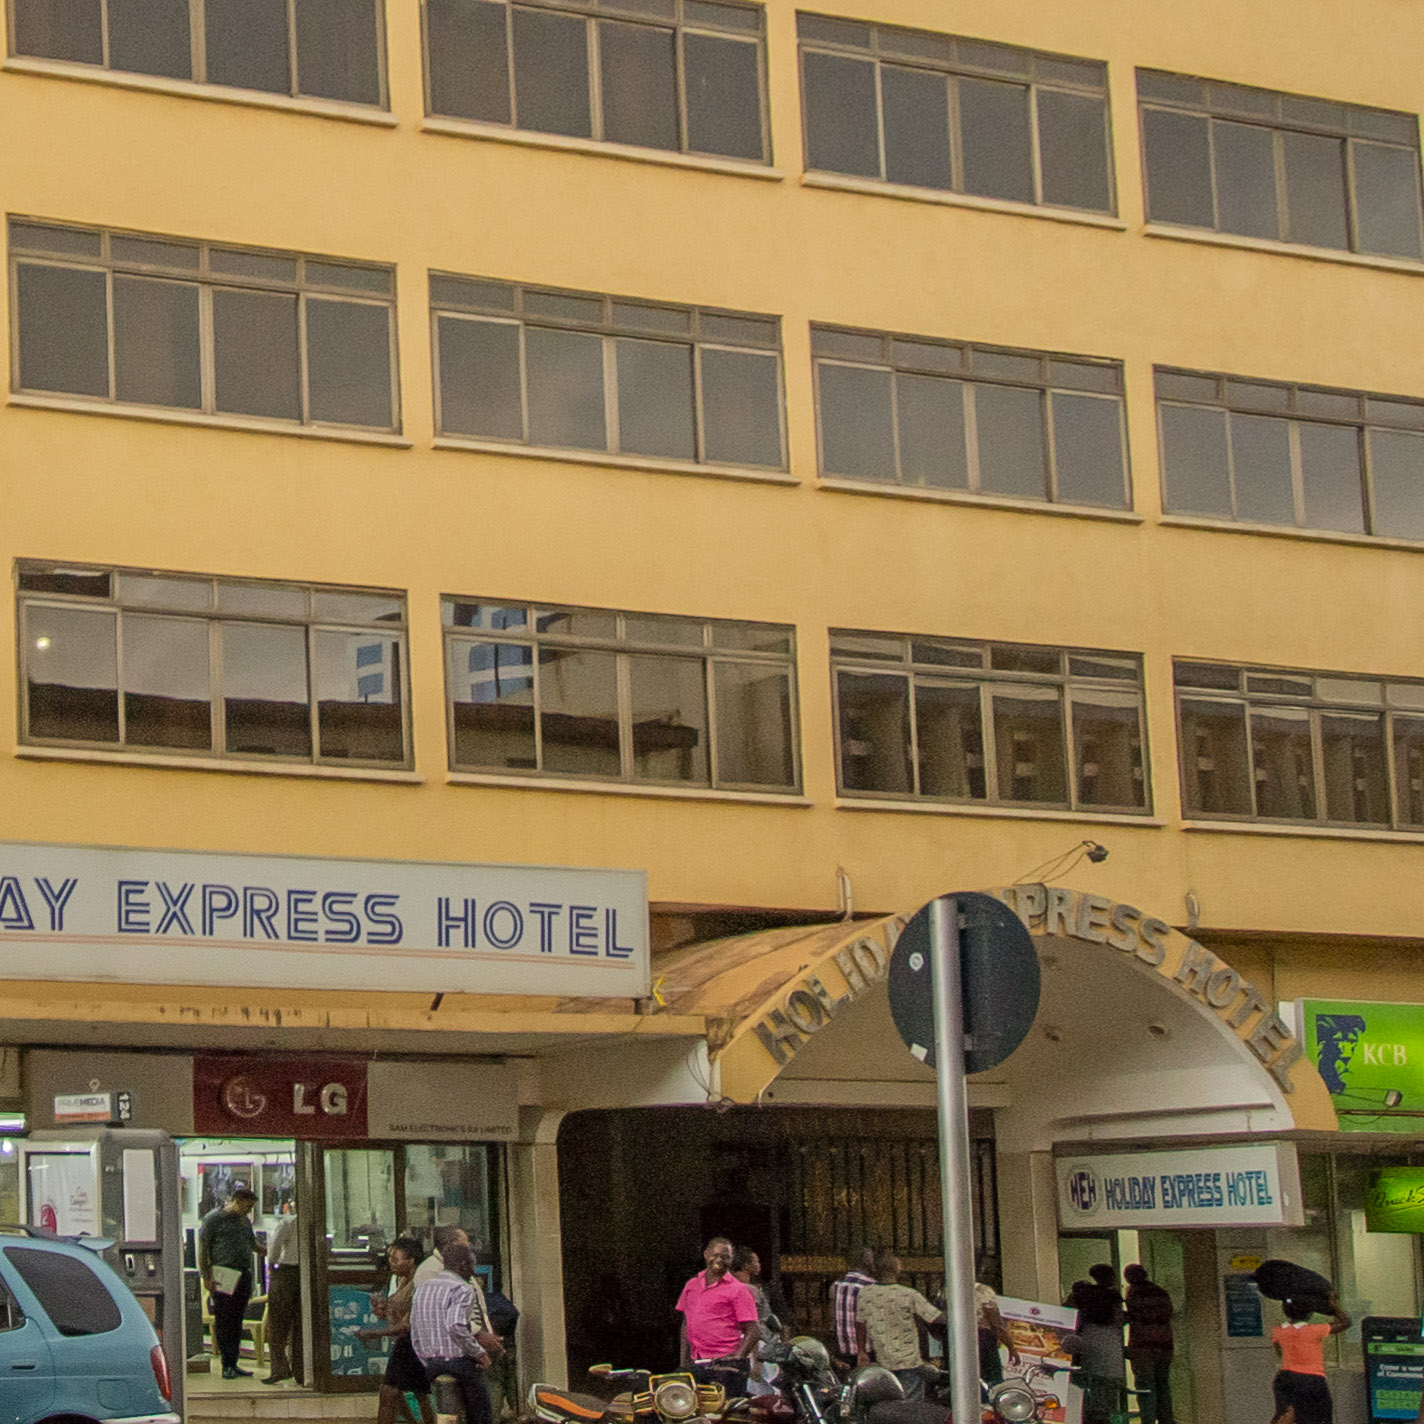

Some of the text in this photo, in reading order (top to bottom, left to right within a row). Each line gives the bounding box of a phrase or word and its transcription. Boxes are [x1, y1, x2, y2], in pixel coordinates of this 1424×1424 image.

[117, 880, 403, 945] EXPRESS
[437, 897, 634, 958] HOTEL
[750, 882, 1304, 1094] HOLID PRESS HOTEL
[1363, 1042, 1407, 1066] KCB
[293, 1082, 348, 1115] LG
[1104, 1170, 1273, 1211] HOLIDAY EXPRESS HOTEL
